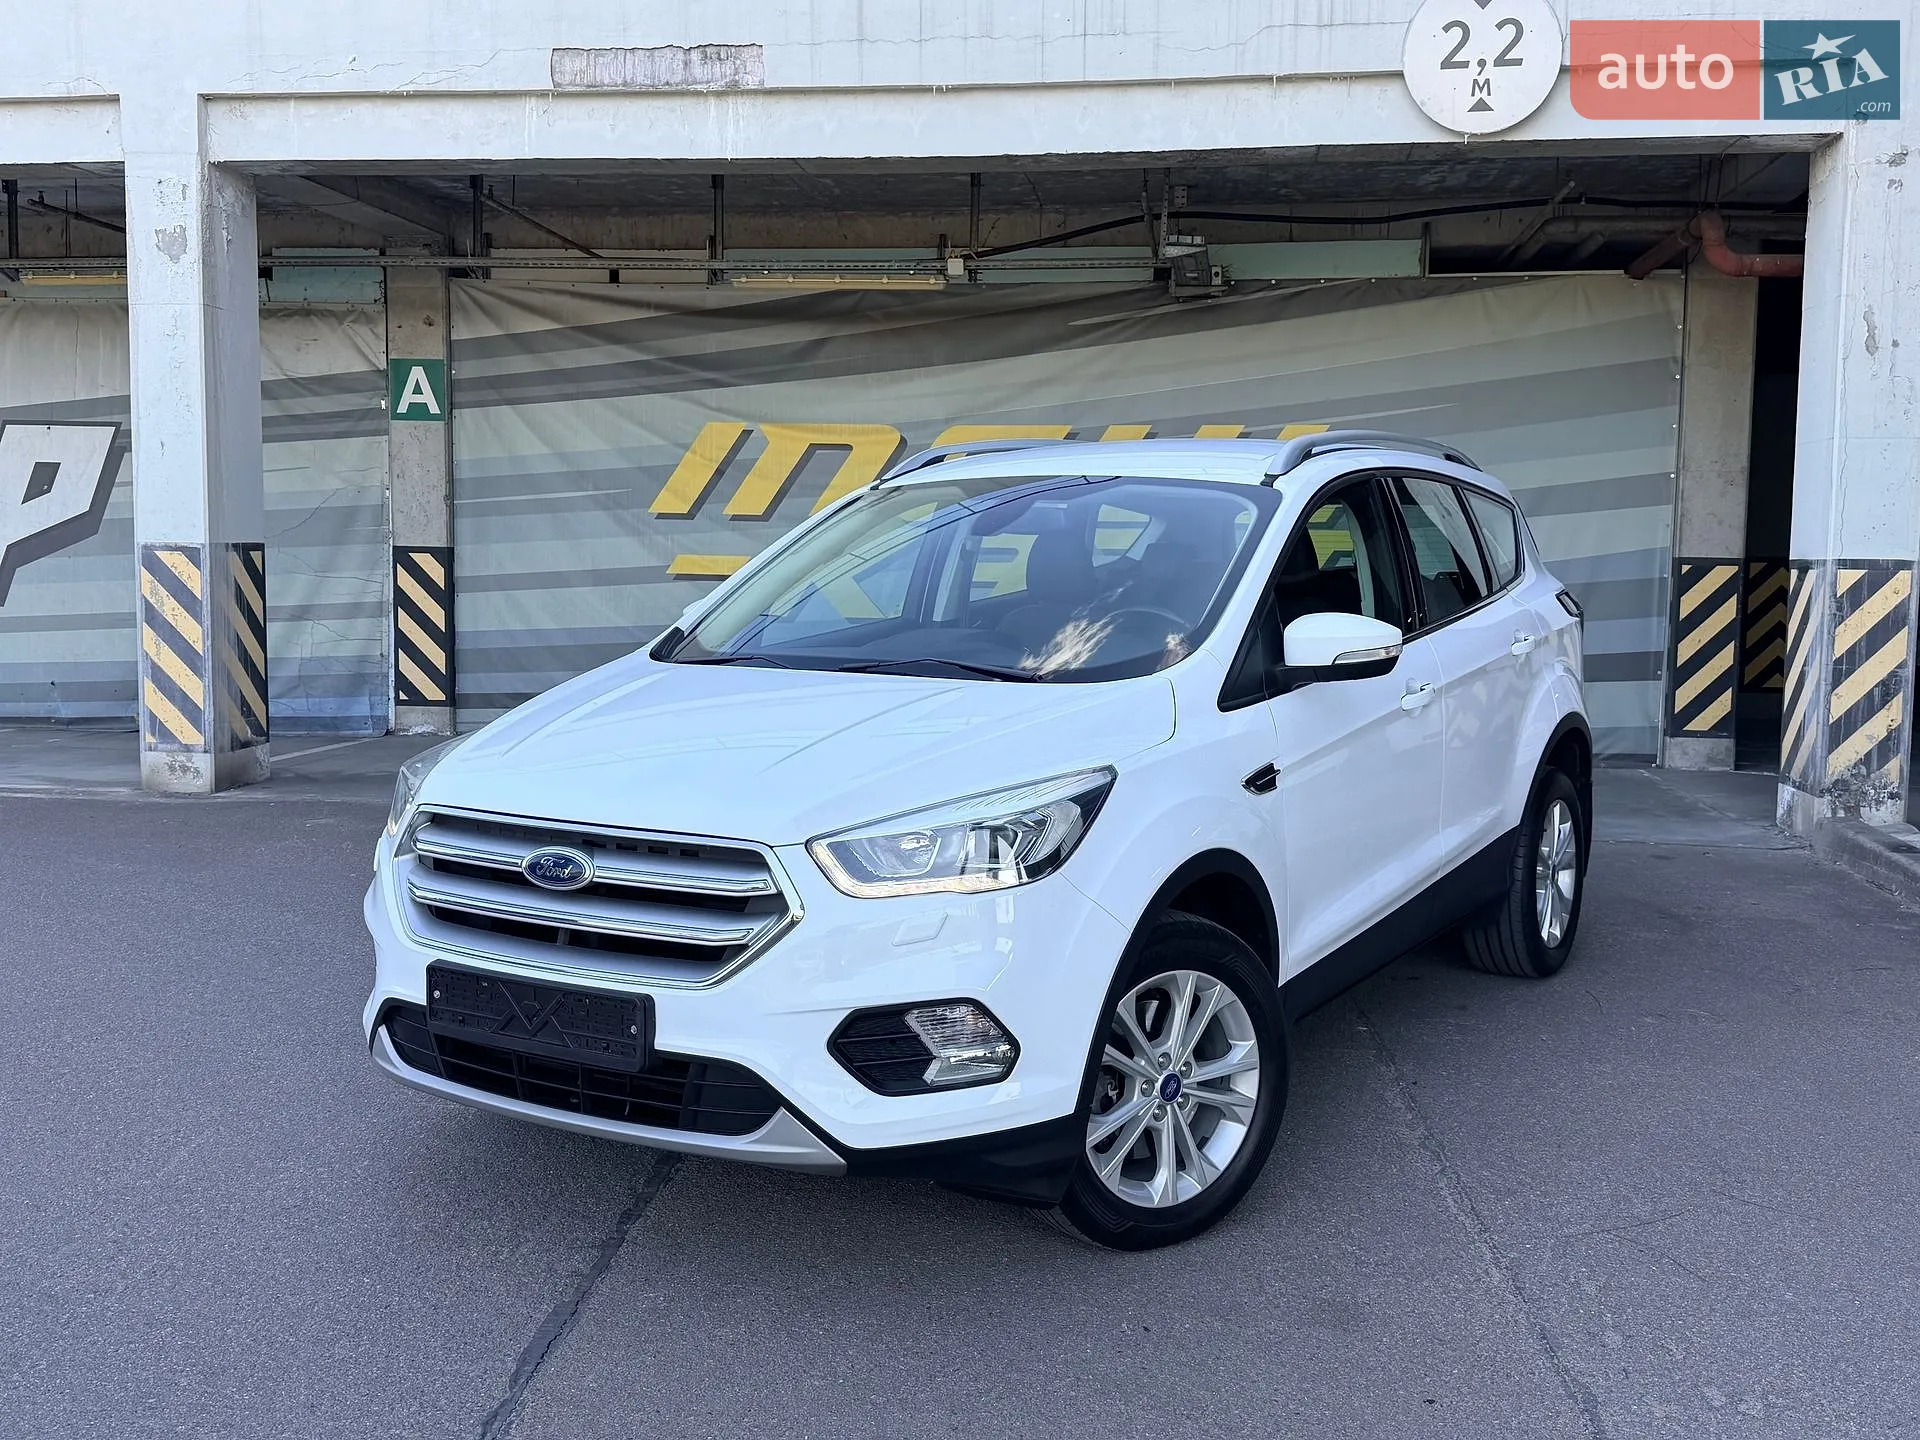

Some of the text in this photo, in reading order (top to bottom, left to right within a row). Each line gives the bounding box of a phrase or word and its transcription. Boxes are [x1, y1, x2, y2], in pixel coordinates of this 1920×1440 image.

[1440, 18, 1525, 76] 2,2
[396, 366, 440, 414] A
[536, 856, 573, 879] Ford
